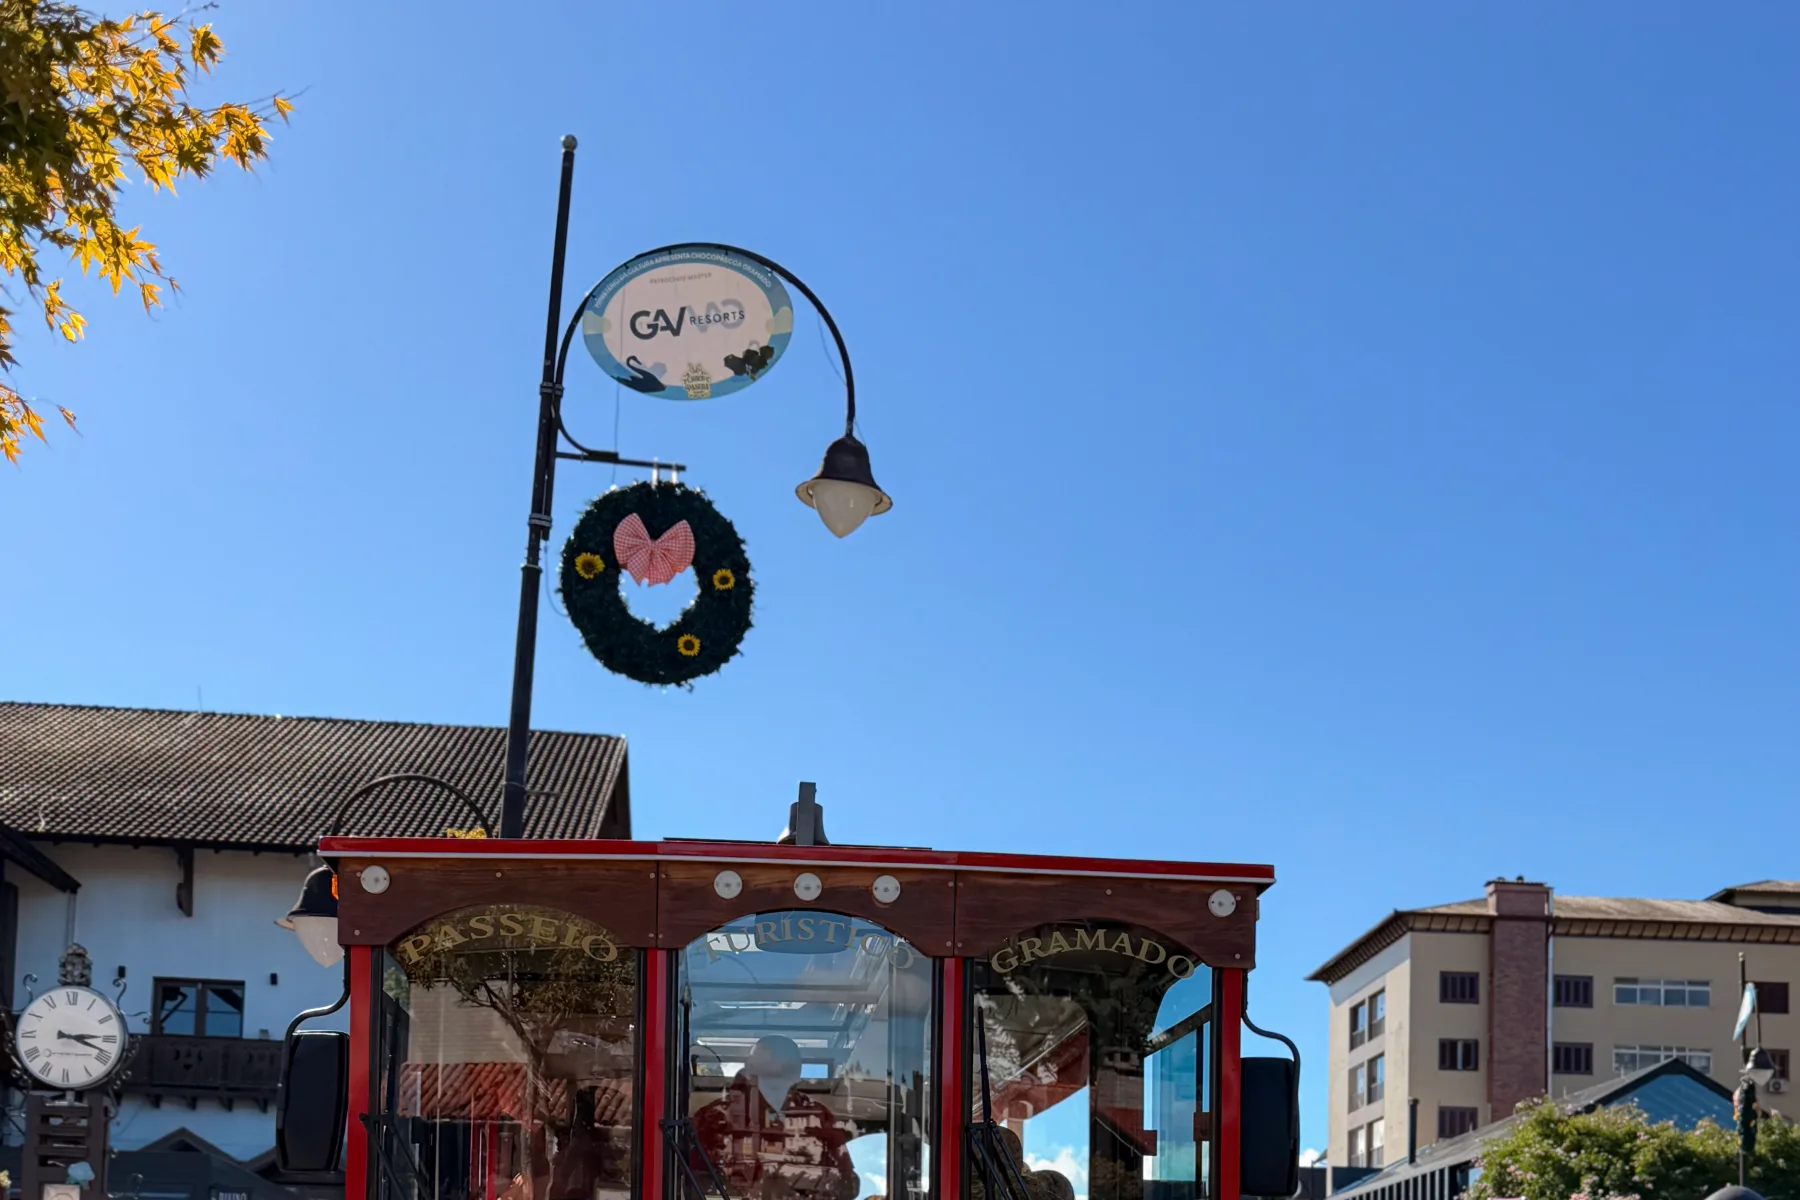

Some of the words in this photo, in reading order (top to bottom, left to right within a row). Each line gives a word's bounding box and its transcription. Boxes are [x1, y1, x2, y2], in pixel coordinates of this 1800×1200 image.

[627, 259, 655, 275] CULTURA
[629, 306, 687, 340] GAV
[689, 310, 745, 325] RESORTS
[402, 913, 619, 965] PASSEIO
[705, 917, 914, 969] TURISTICO
[990, 928, 1196, 981] GRAMADO
